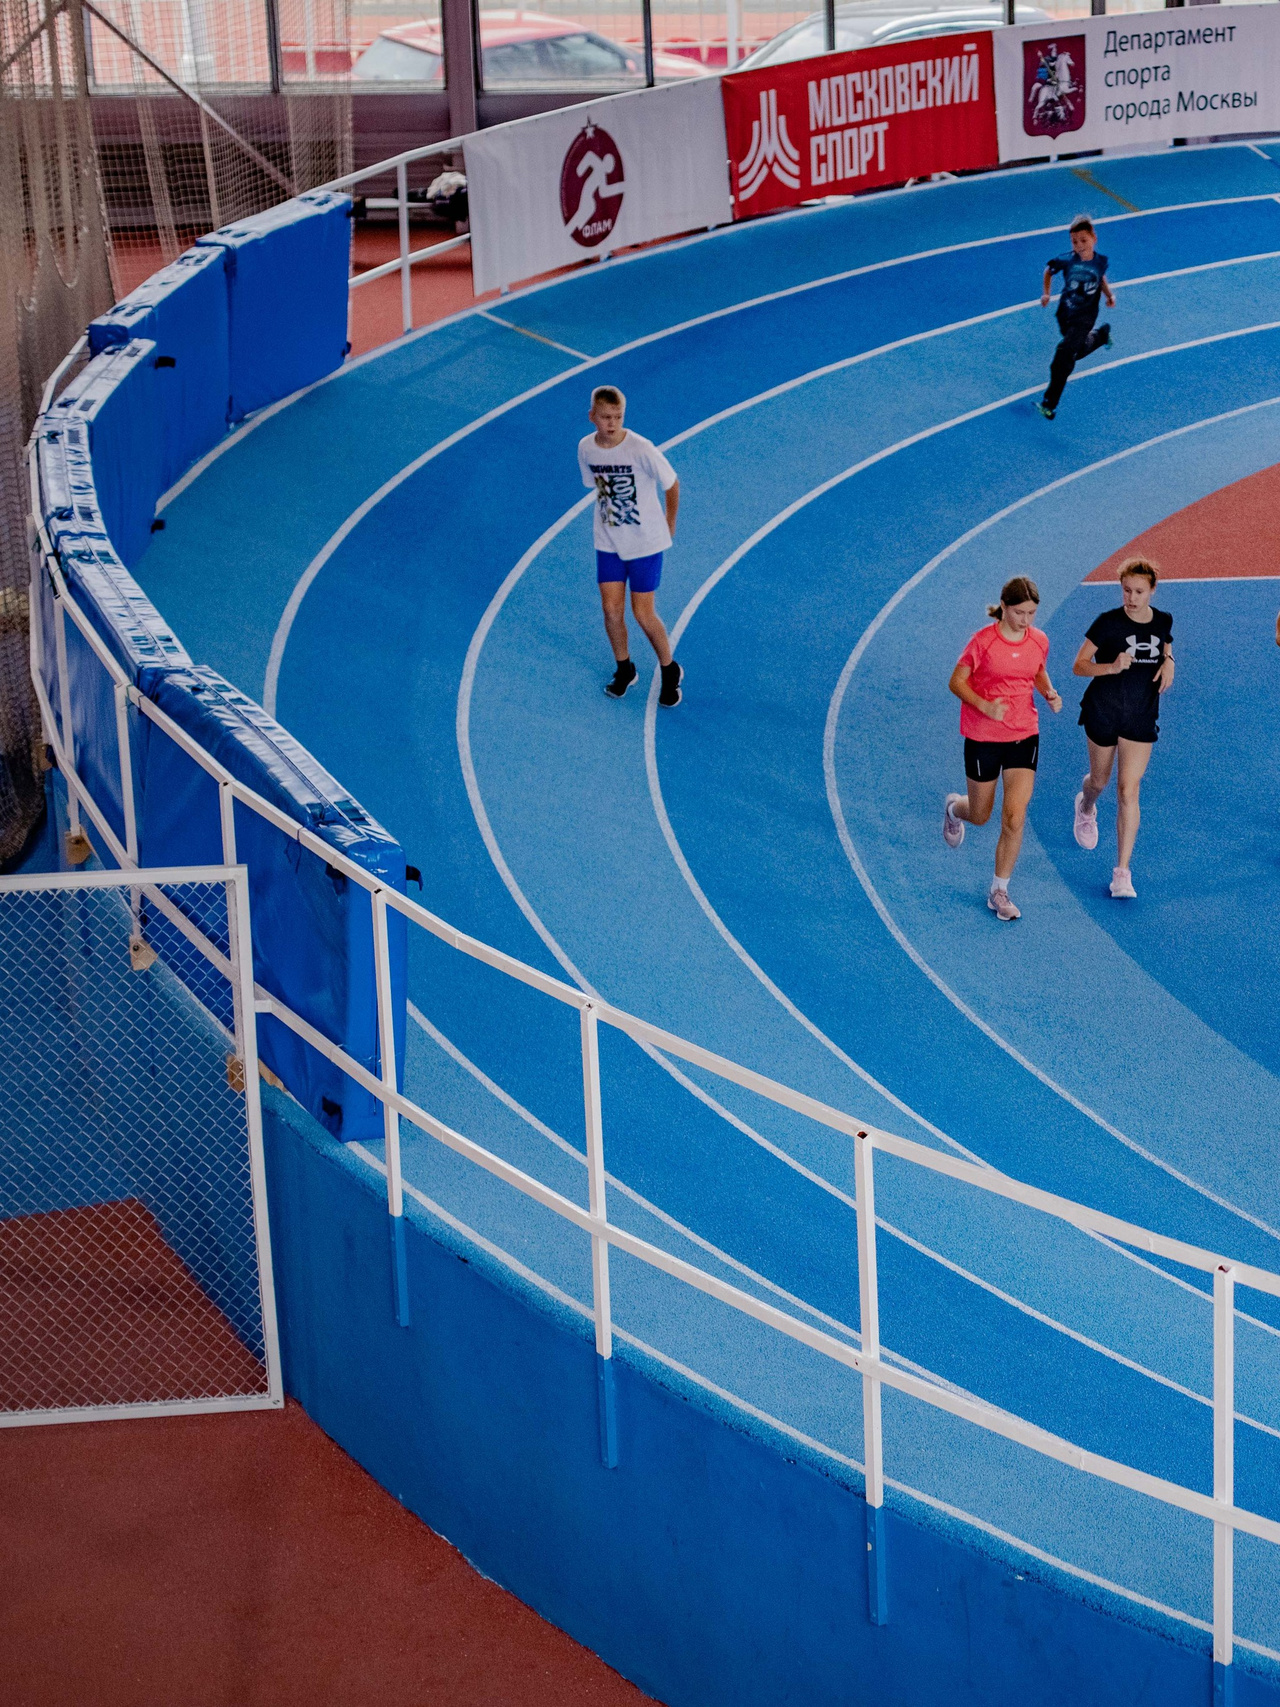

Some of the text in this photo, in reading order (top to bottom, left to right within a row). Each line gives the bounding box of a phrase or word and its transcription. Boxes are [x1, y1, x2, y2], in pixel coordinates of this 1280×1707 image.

[1103, 25, 1237, 58] Департамент
[807, 42, 979, 132] МОСКОВСКИЙ
[1104, 64, 1171, 89] спорта
[1104, 90, 1258, 125] города Москвы
[809, 121, 889, 187] СПОРТ
